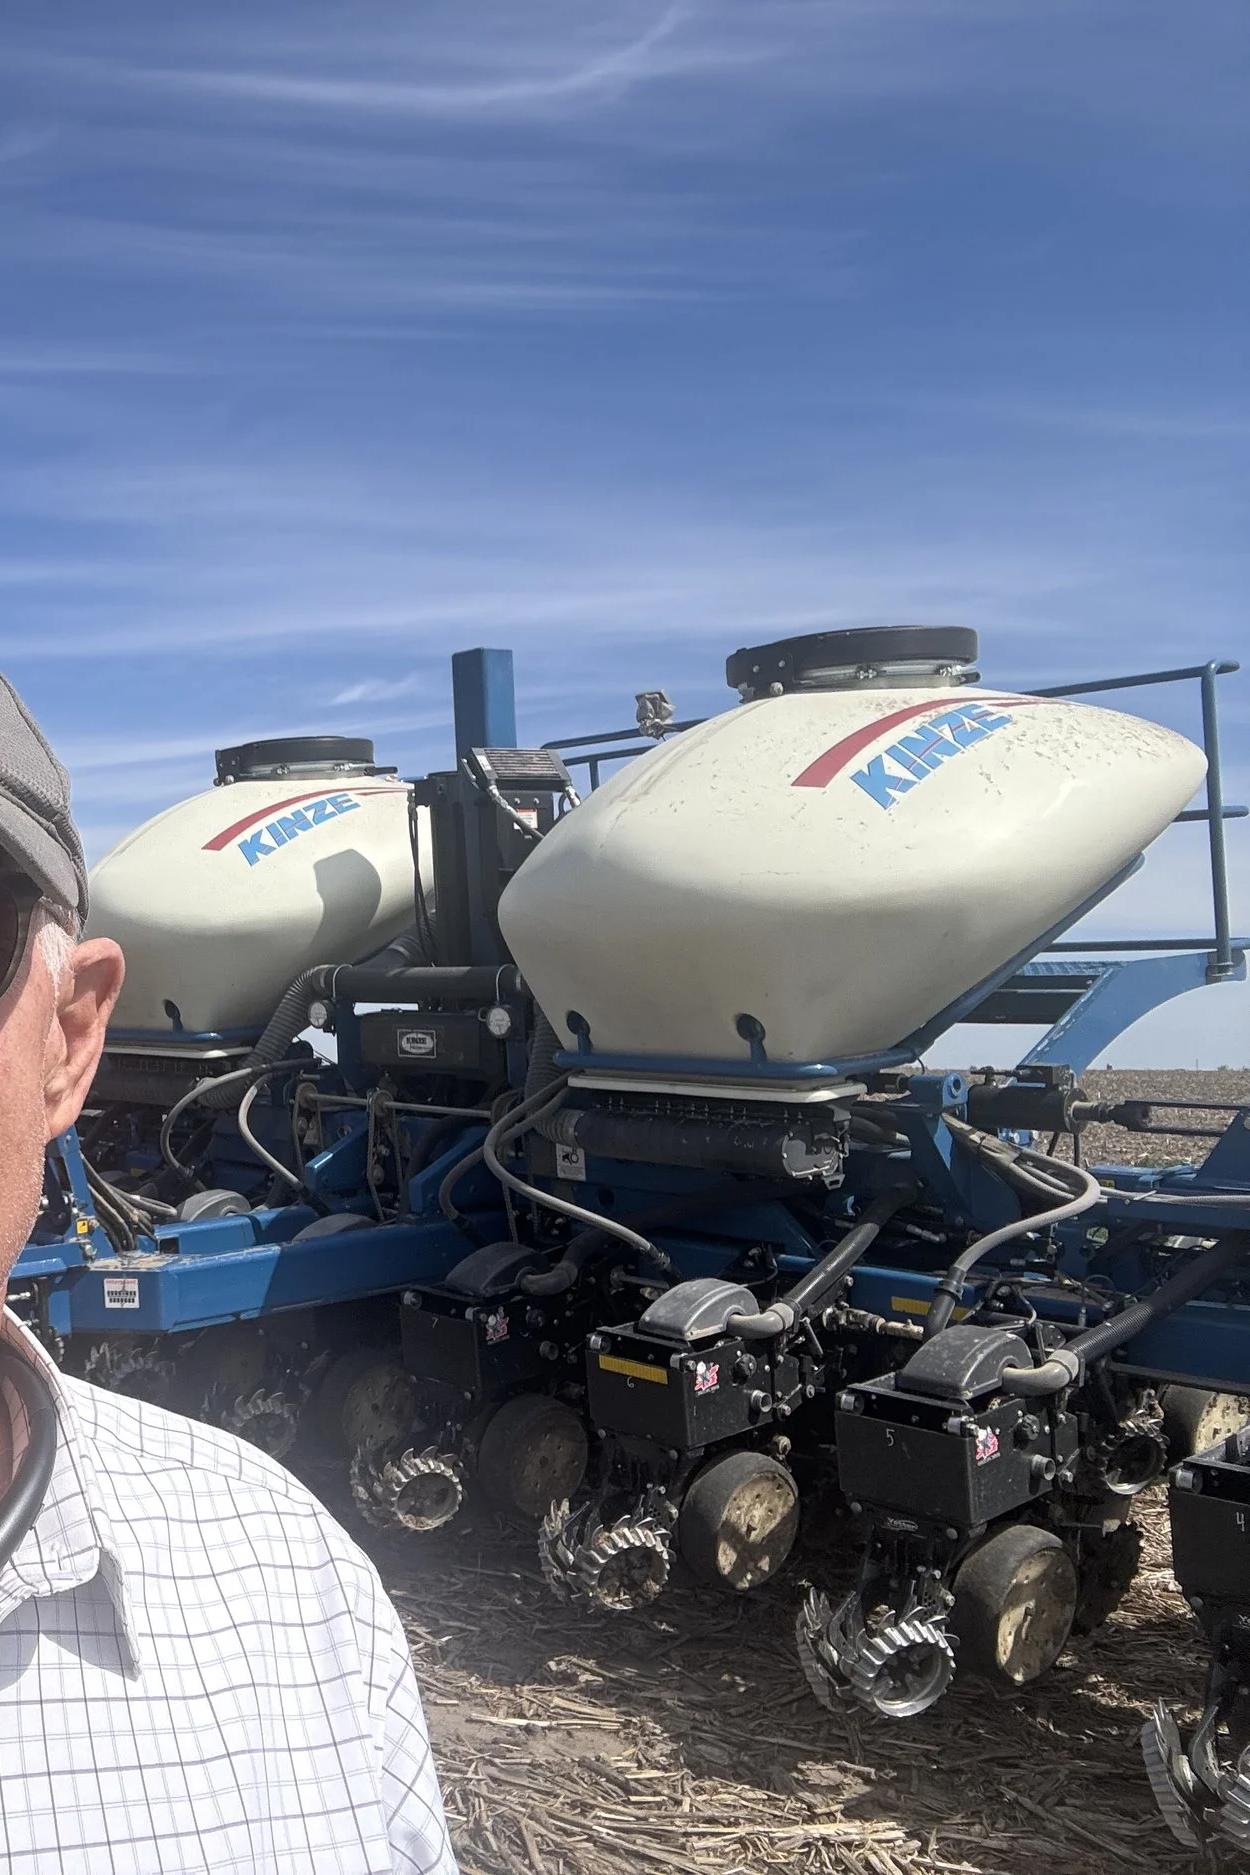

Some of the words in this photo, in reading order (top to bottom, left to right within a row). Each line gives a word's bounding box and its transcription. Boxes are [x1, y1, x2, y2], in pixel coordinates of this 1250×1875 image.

[850, 703, 1014, 811] KINZE
[237, 793, 361, 867] KINZE
[431, 1316, 439, 1328] 7
[626, 1376, 635, 1388] 6
[886, 1428, 895, 1447] 5
[1236, 1511, 1245, 1532] 4
